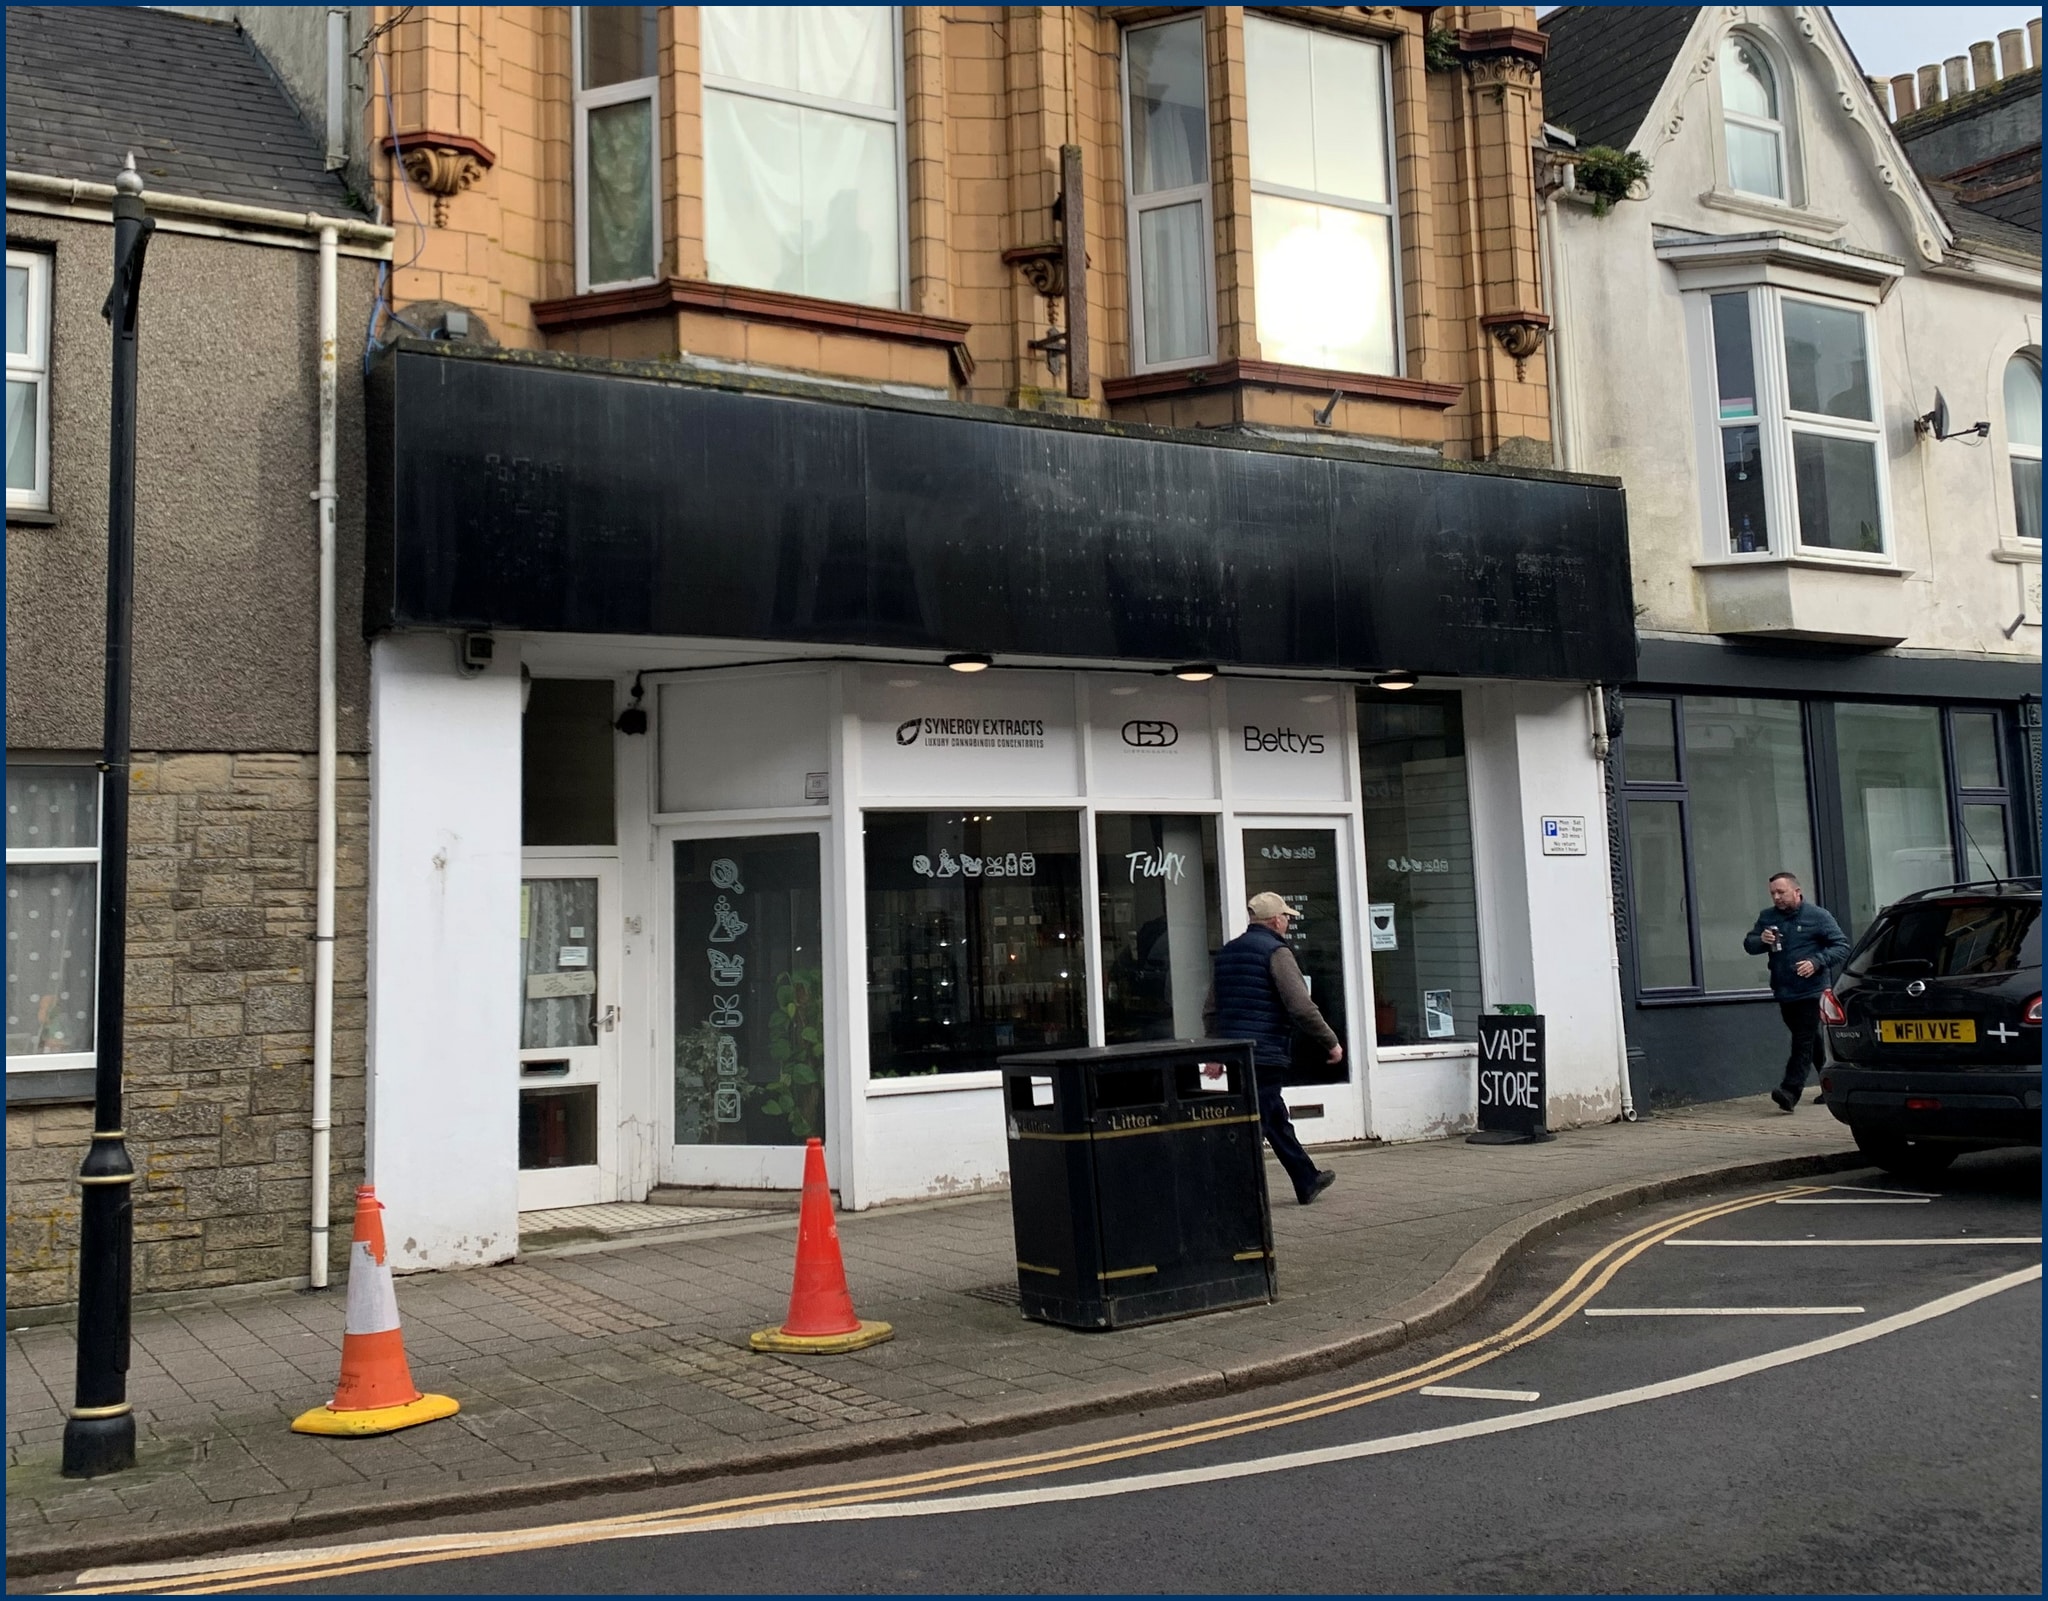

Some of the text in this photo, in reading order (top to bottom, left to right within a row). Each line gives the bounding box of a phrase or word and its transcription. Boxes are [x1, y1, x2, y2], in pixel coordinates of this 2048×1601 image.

[924, 717, 1044, 736] SYNERGY EXTRACTS
[924, 737, 1044, 749] LUXURY CANNABINOID CONCENTRATES
[1244, 725, 1325, 754] Bettys
[1125, 846, 1186, 886] T-WAX
[1927, 1022, 1962, 1040] VVE
[1480, 1028, 1537, 1063] VAPE
[1480, 1070, 1539, 1109] STORE
[1111, 1114, 1152, 1131] Litter
[1191, 1106, 1230, 1121] Litter
